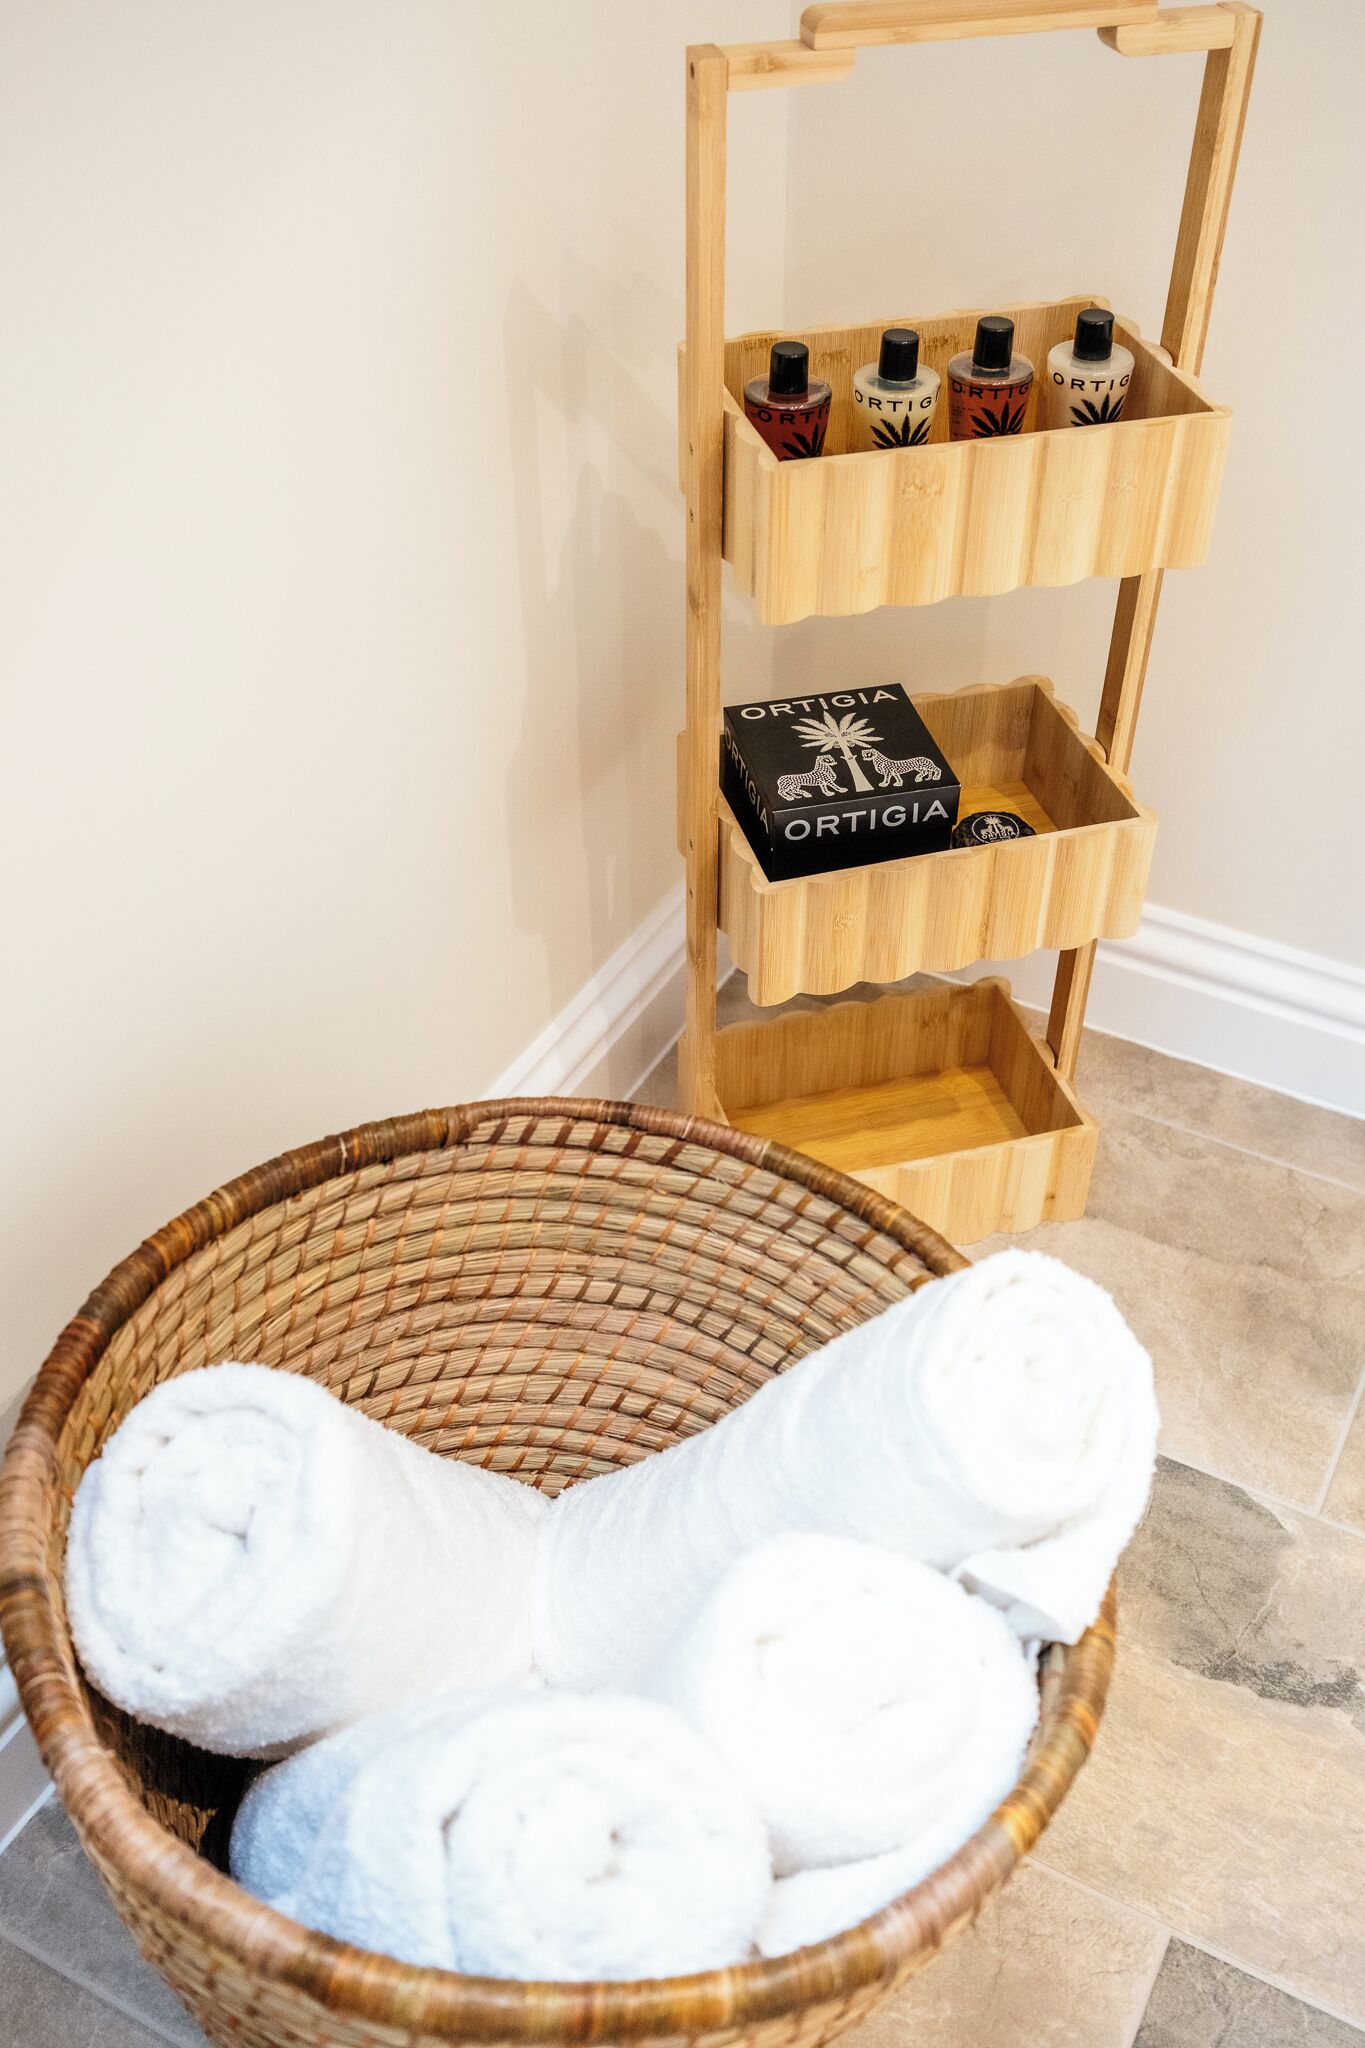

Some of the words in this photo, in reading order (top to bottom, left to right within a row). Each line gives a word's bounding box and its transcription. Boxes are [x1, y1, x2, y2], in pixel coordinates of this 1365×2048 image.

[952, 380, 1029, 400] ORTIG
[1053, 372, 1130, 392] ORTIG
[740, 689, 898, 720] ORTIGIA
[724, 726, 769, 835] ORTIGIA
[784, 800, 949, 841] ORTIGIA
